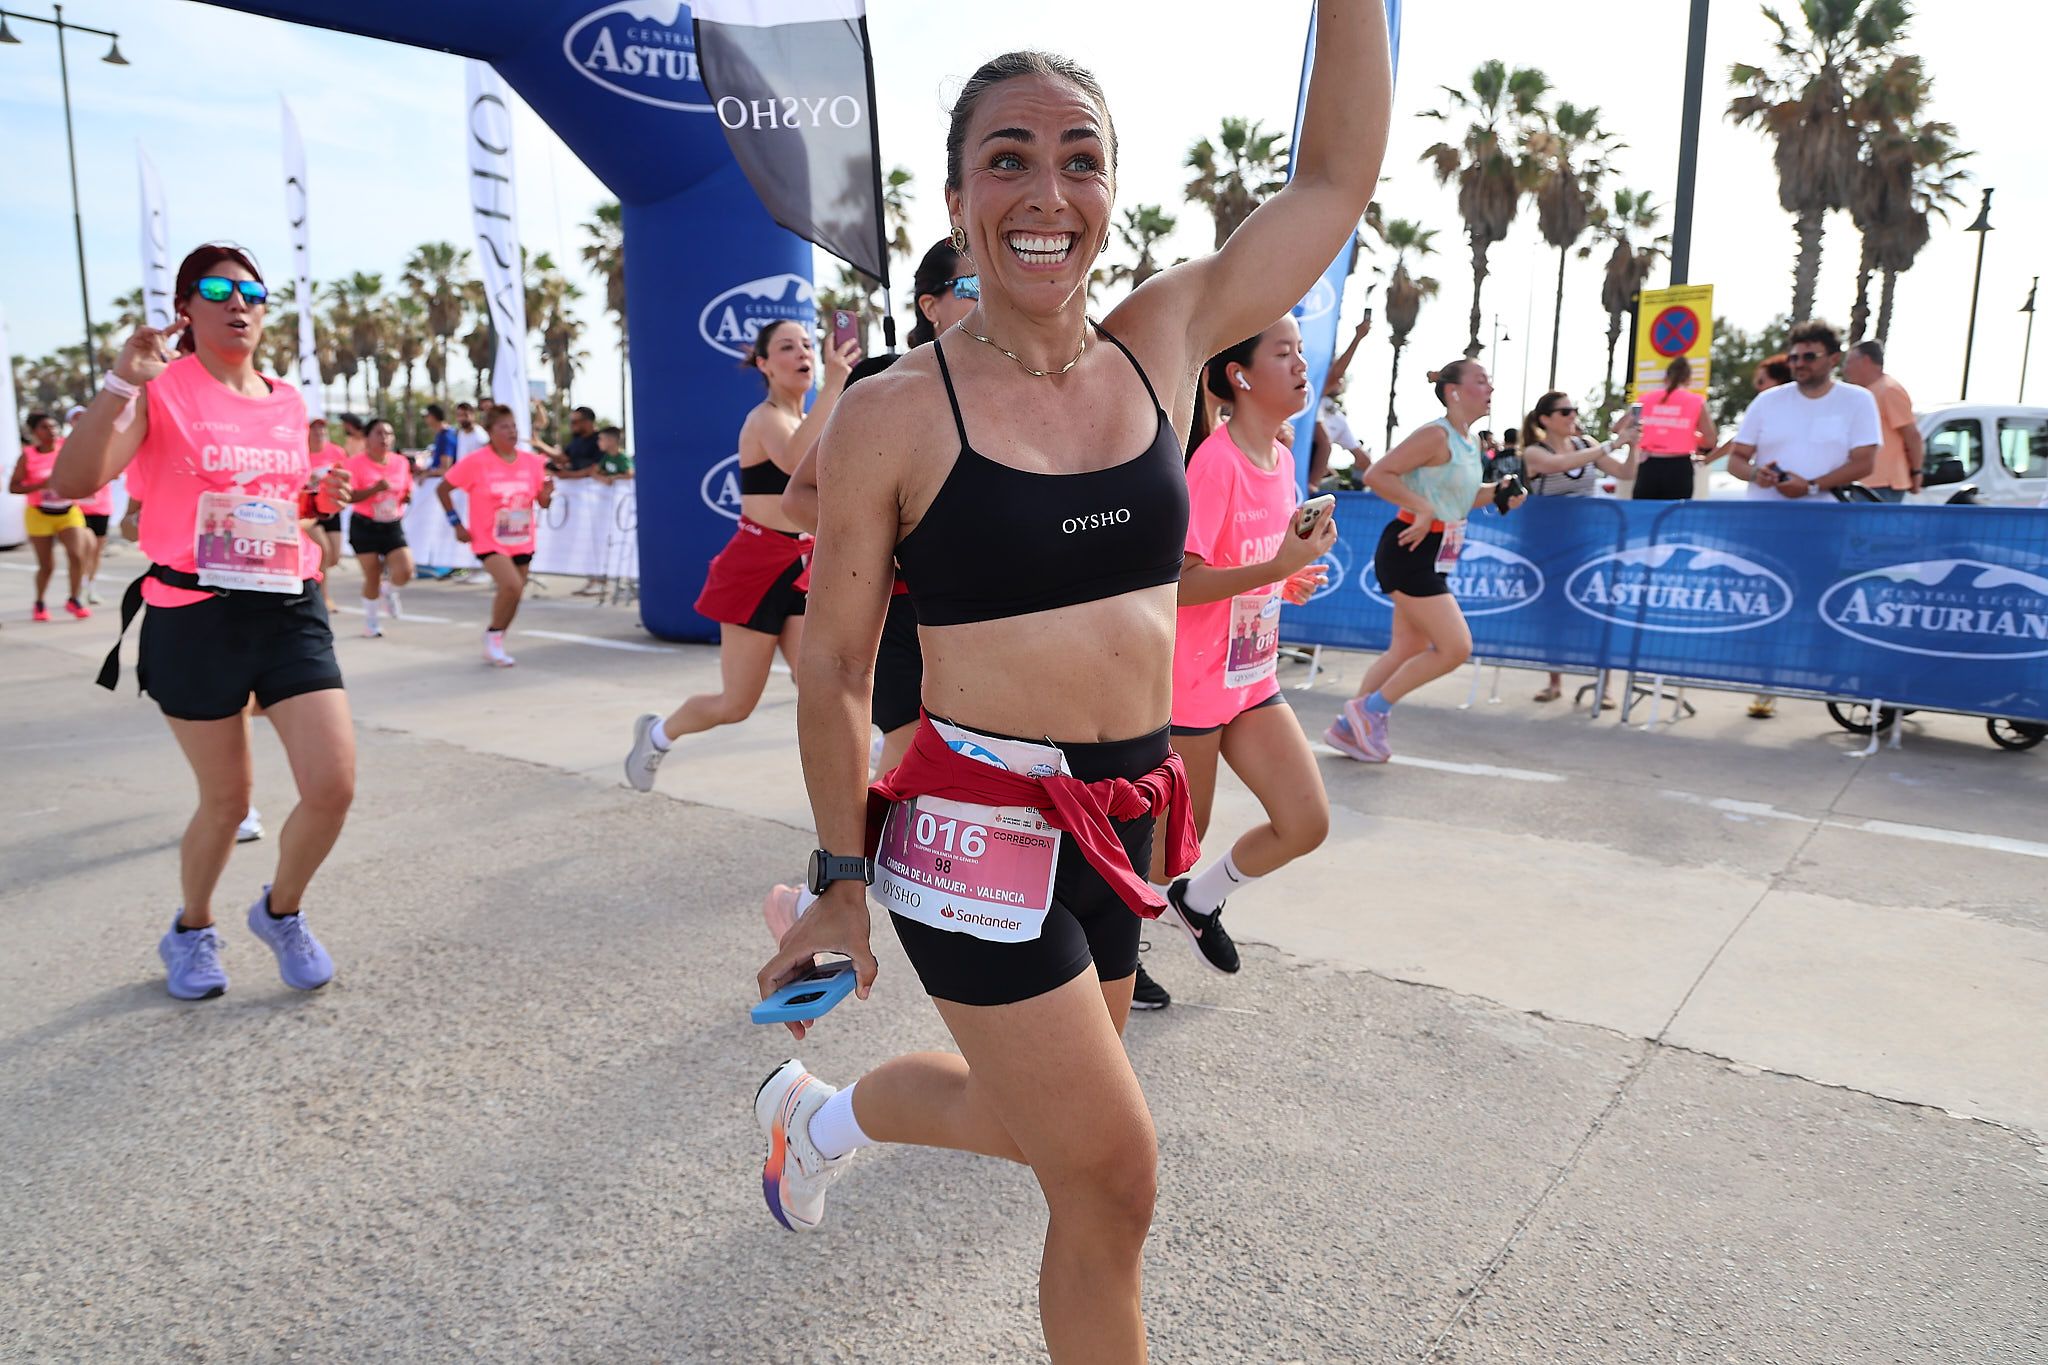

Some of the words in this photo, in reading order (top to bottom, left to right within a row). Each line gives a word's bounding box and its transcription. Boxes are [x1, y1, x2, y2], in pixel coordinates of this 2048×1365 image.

[1062, 508, 1131, 534] OYSHO
[233, 538, 277, 557] 016
[1580, 571, 1771, 615] ASTURIANA
[1837, 588, 2048, 640] ASTURIAN
[916, 813, 988, 858] 016
[993, 831, 1051, 848] CORREDORA
[886, 857, 909, 877] CARRERA
[910, 868, 921, 881] DE
[922, 872, 933, 885] LA
[934, 876, 967, 894] MUJER
[975, 886, 1025, 904] VALENCIA
[934, 858, 952, 874] 98
[882, 879, 921, 908] OYSHO
[956, 909, 1022, 931] Santander
